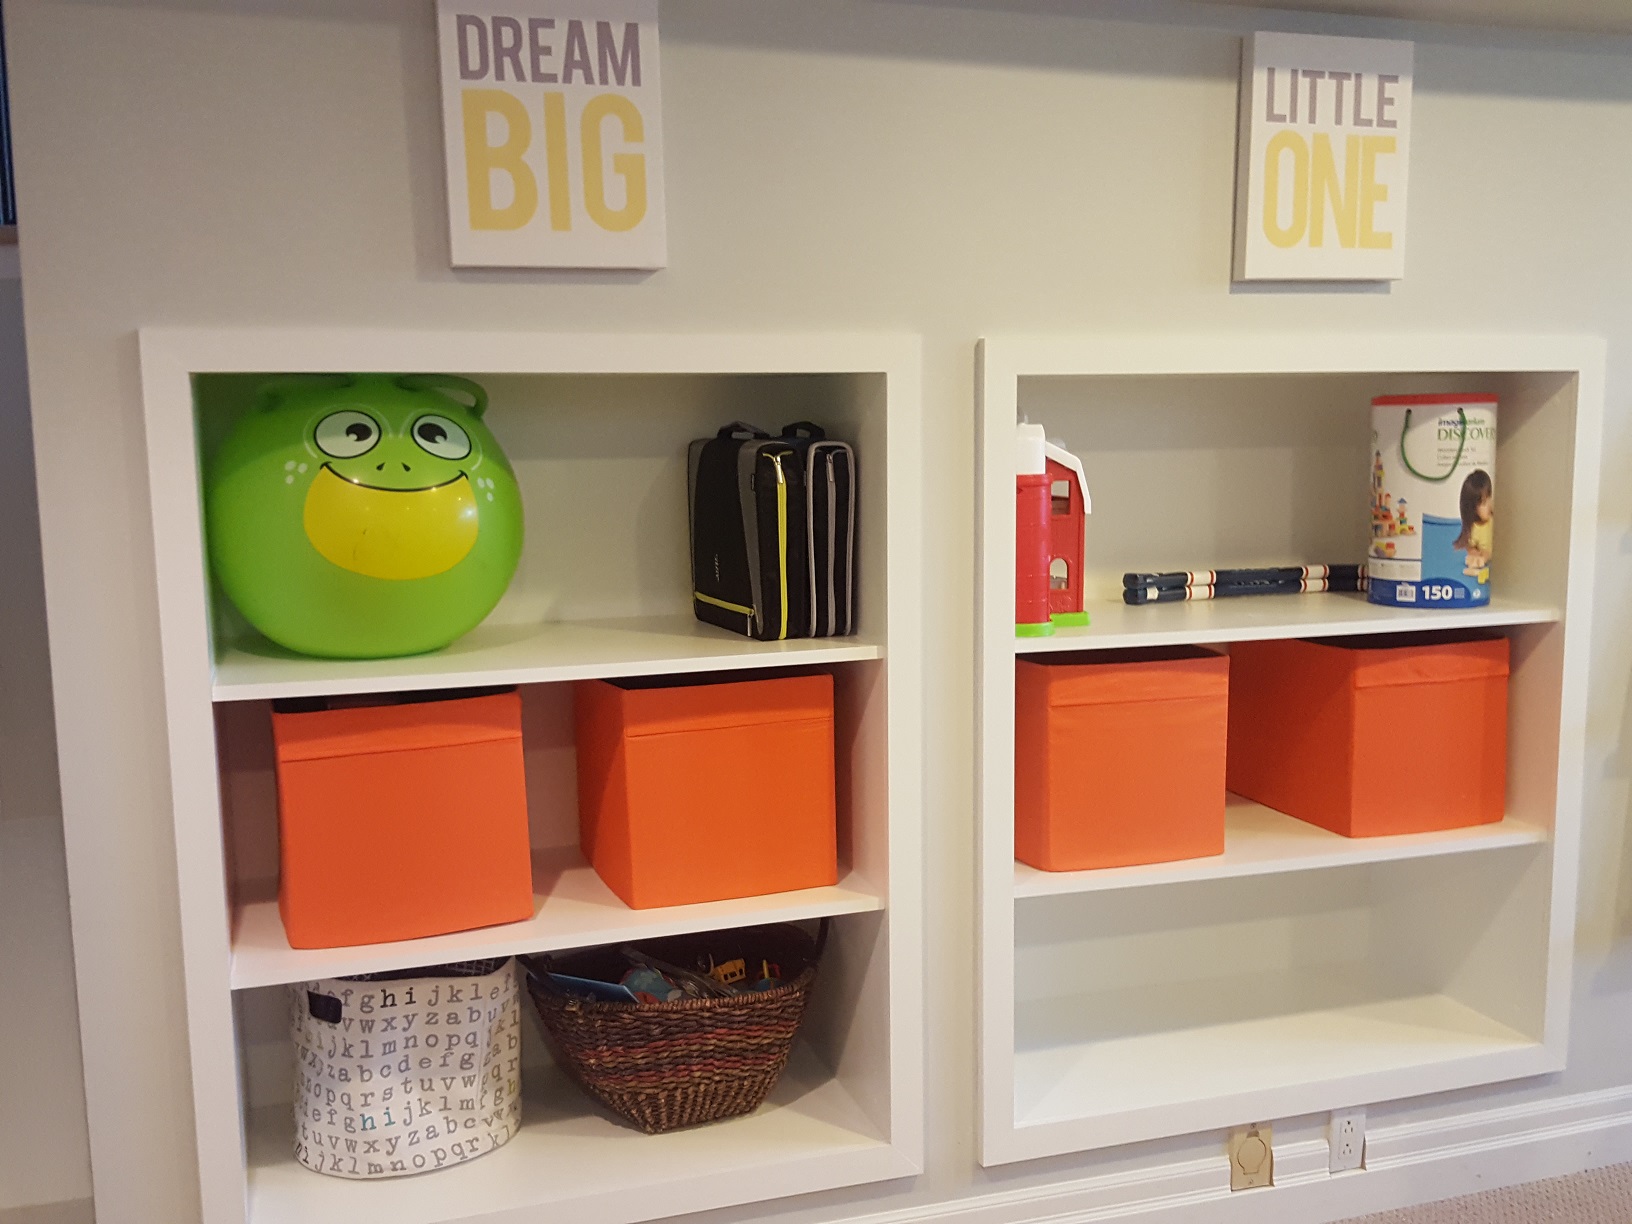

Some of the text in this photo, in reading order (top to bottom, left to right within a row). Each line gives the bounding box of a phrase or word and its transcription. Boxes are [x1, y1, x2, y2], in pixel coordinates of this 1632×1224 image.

[456, 14, 642, 87] DREAM
[1266, 67, 1399, 129] LITTLE
[461, 89, 648, 232] BIG
[1262, 129, 1397, 249] ONE
[1422, 585, 1453, 601] 150
